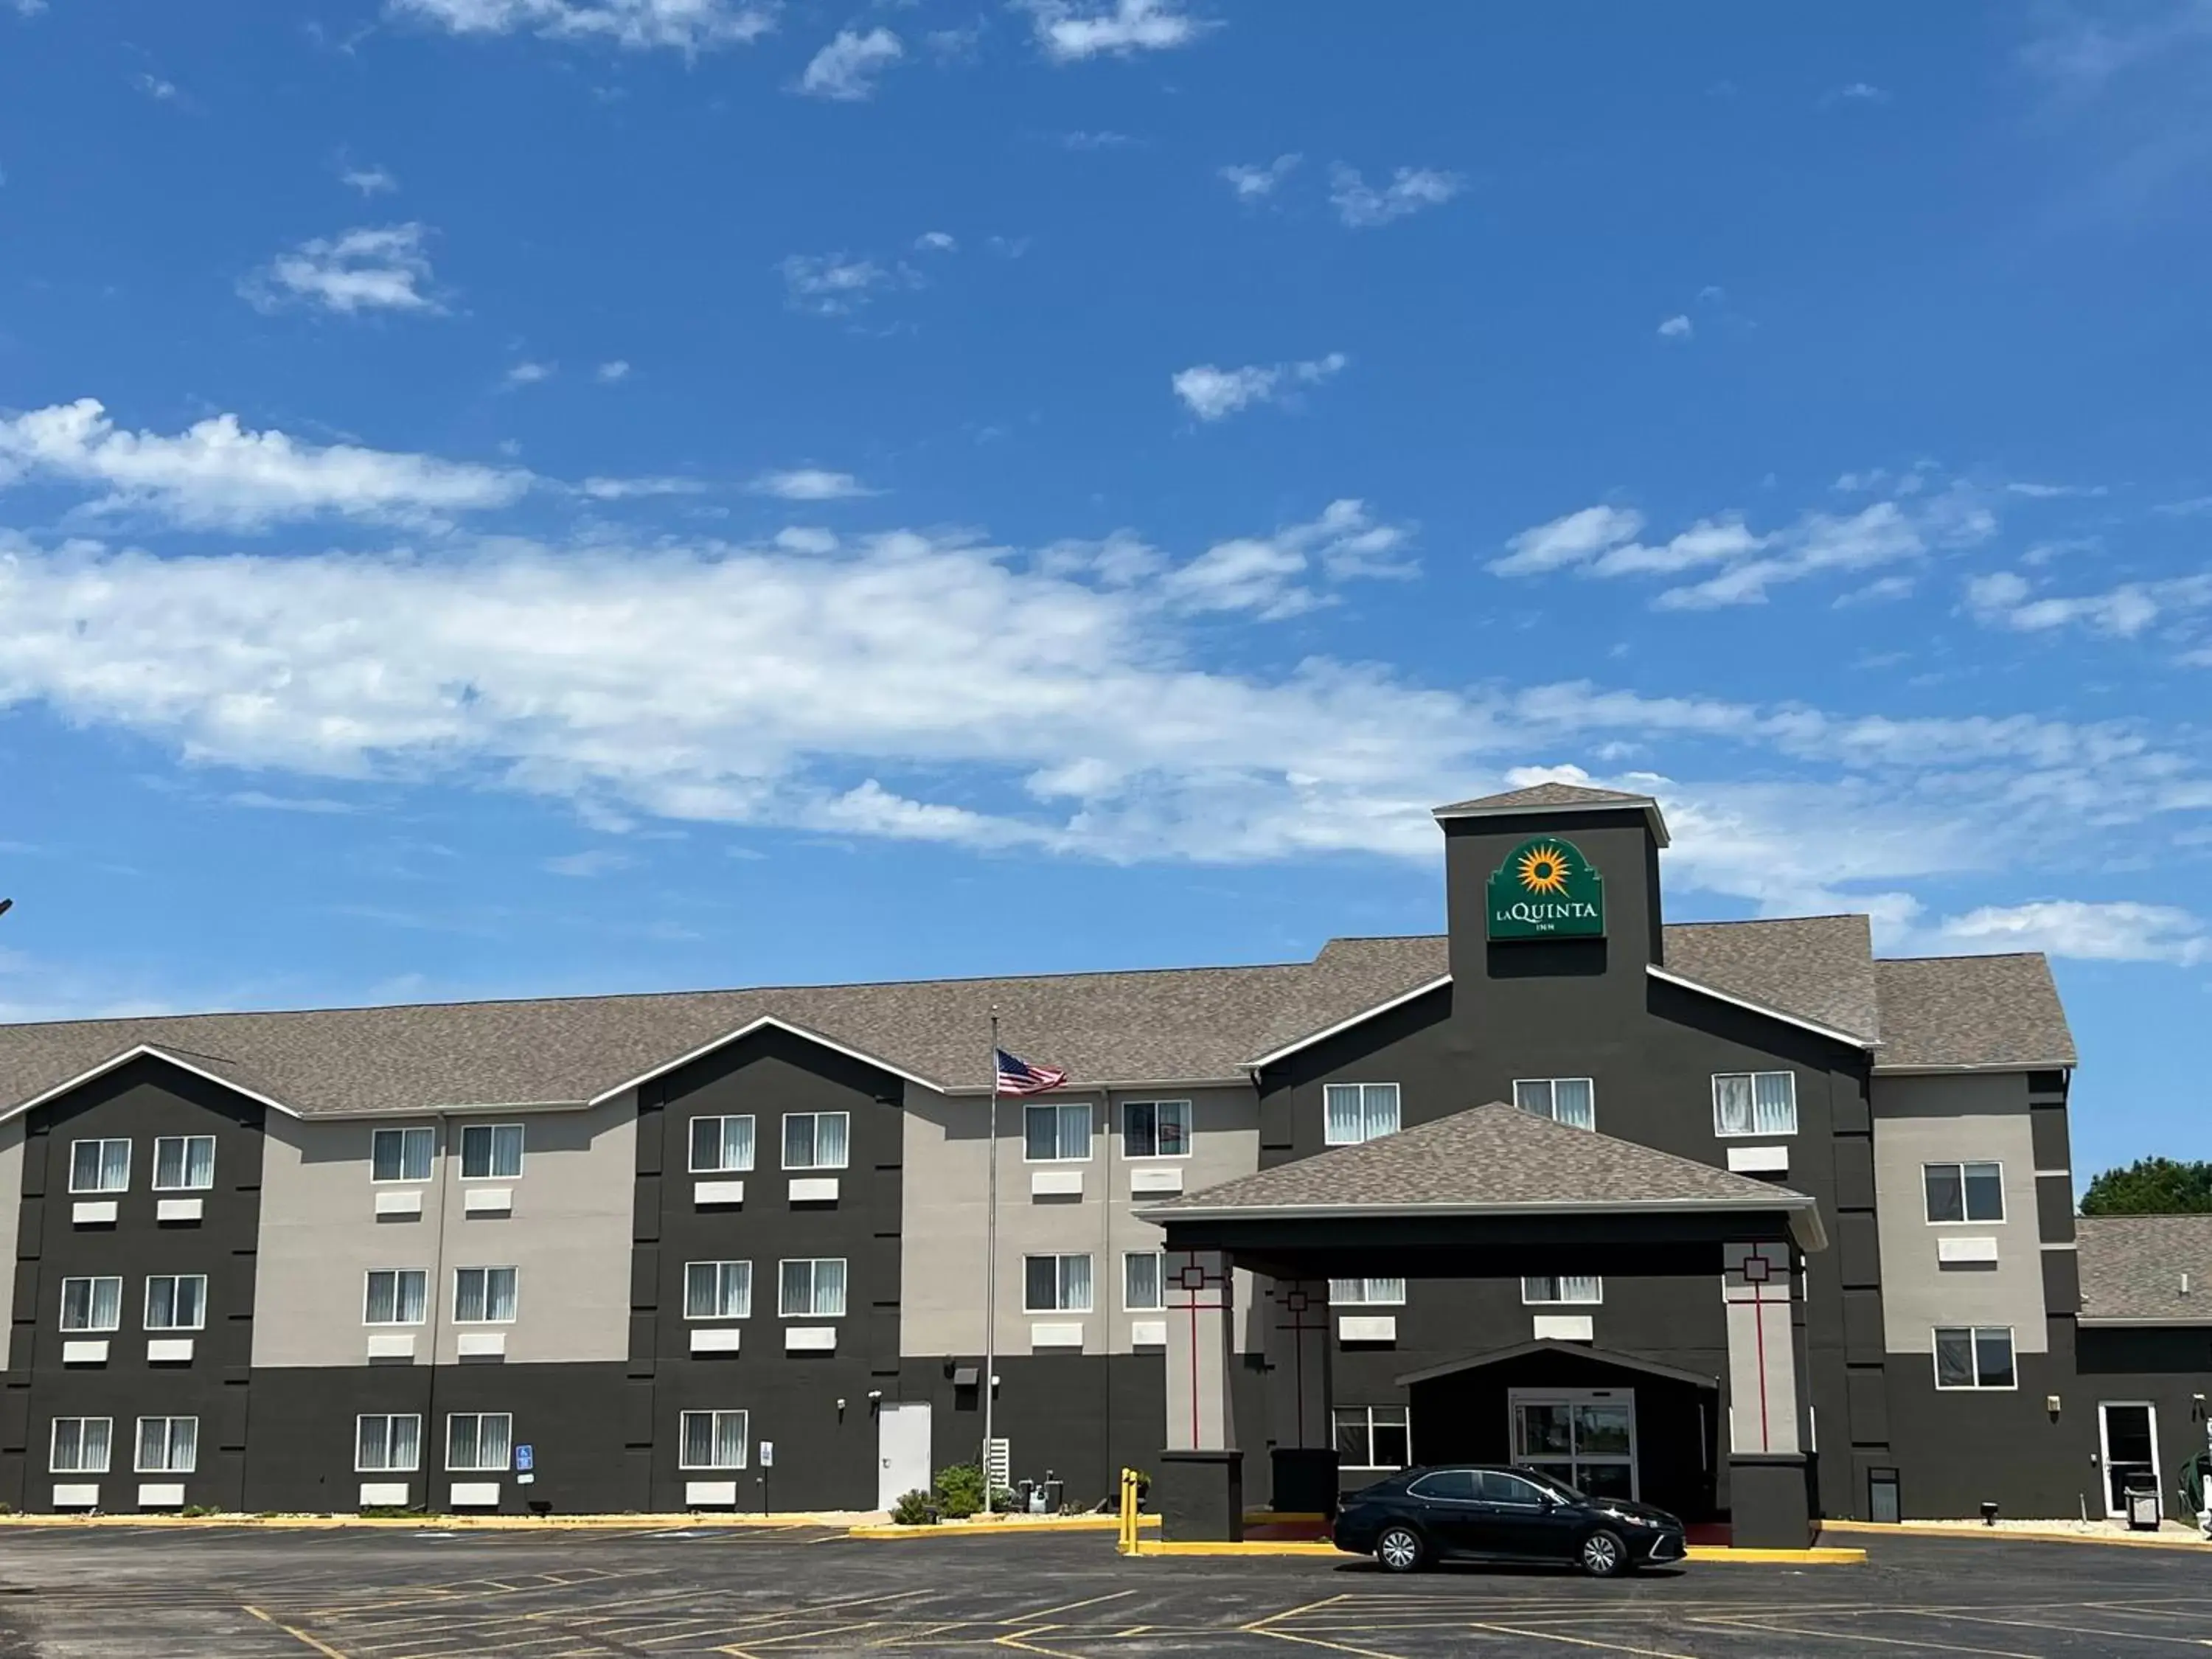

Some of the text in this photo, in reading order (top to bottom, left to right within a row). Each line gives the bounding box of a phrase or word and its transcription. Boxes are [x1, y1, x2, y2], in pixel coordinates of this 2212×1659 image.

[1496, 902, 1598, 924] LA QUINTA
[1536, 923, 1554, 931] INN
